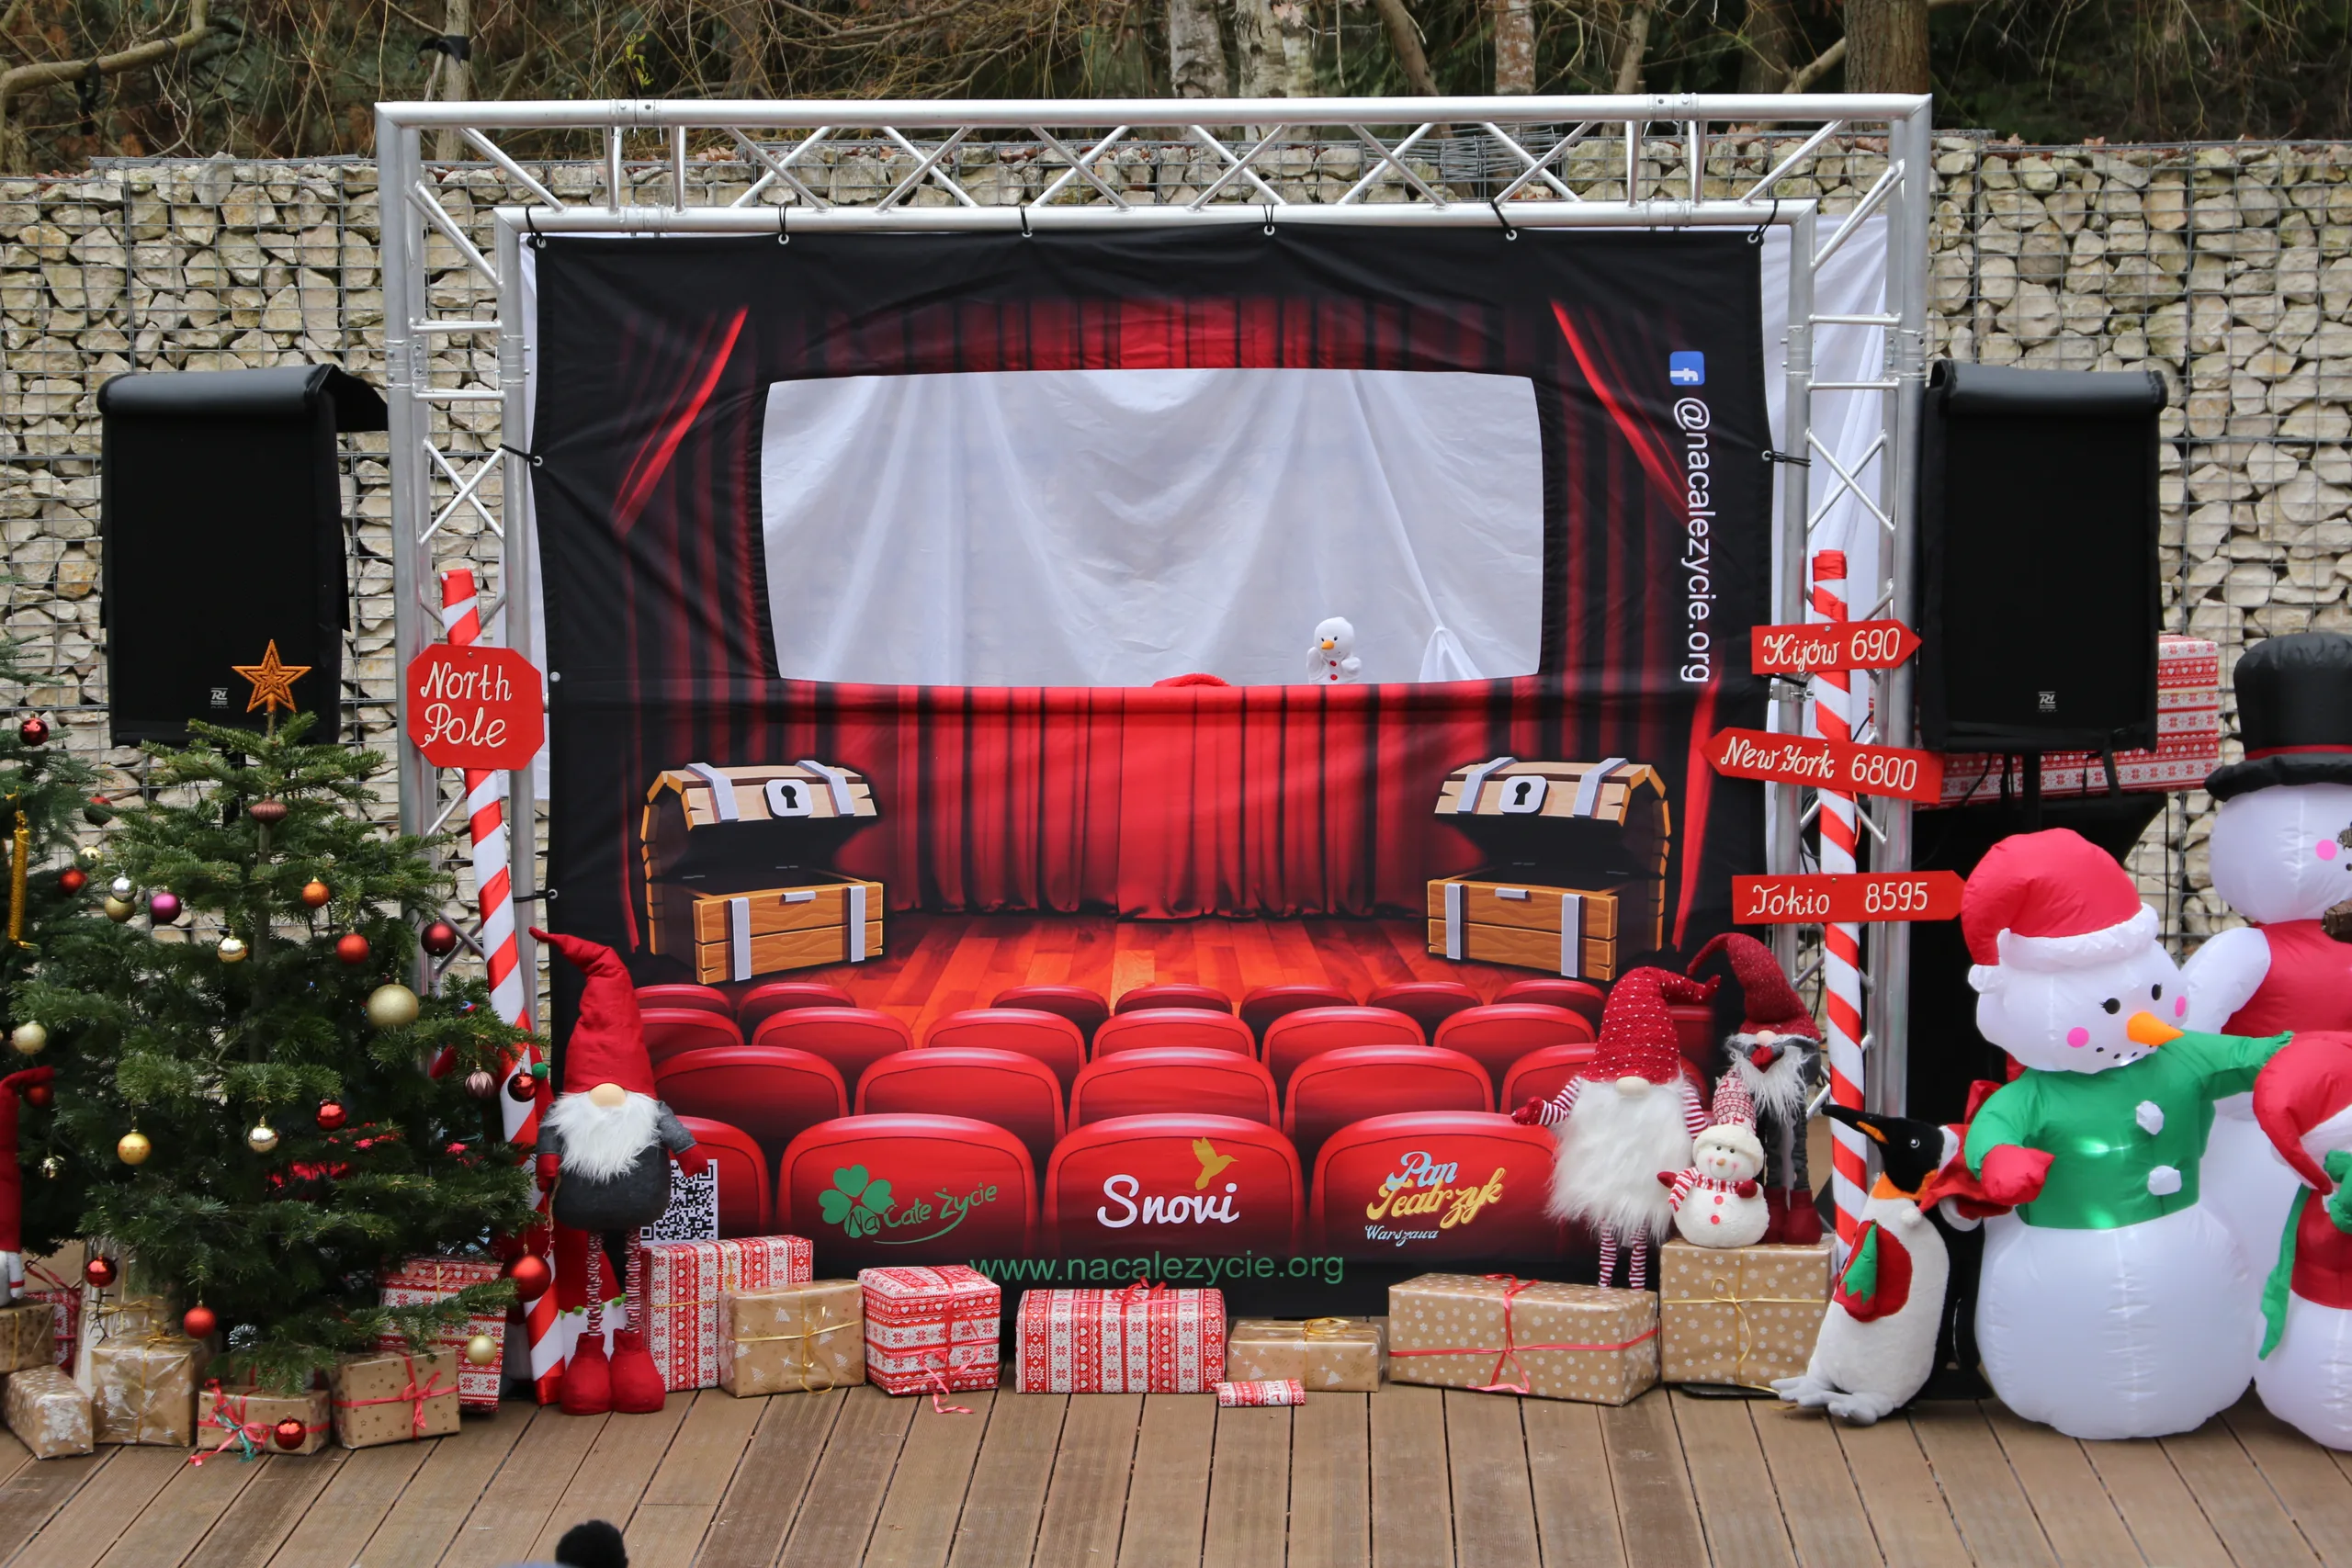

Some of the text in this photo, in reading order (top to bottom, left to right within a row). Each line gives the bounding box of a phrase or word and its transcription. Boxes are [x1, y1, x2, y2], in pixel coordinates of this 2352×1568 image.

[1673, 396, 1717, 683] @nacalezycie.org
[1762, 626, 1901, 672] Kijów 690
[420, 660, 513, 702] North
[420, 703, 507, 749] Pole
[1720, 736, 1918, 792] New York 6800
[1747, 881, 1928, 917] Tokio 8595
[1385, 1150, 1459, 1190] Pan
[933, 1182, 998, 1222] Życie
[1096, 1174, 1240, 1228] Snovi
[1366, 1167, 1507, 1229] Teatrzyk
[1364, 1224, 1440, 1247] Warszawa
[969, 1249, 1344, 1285] www.nacalezycie.org
